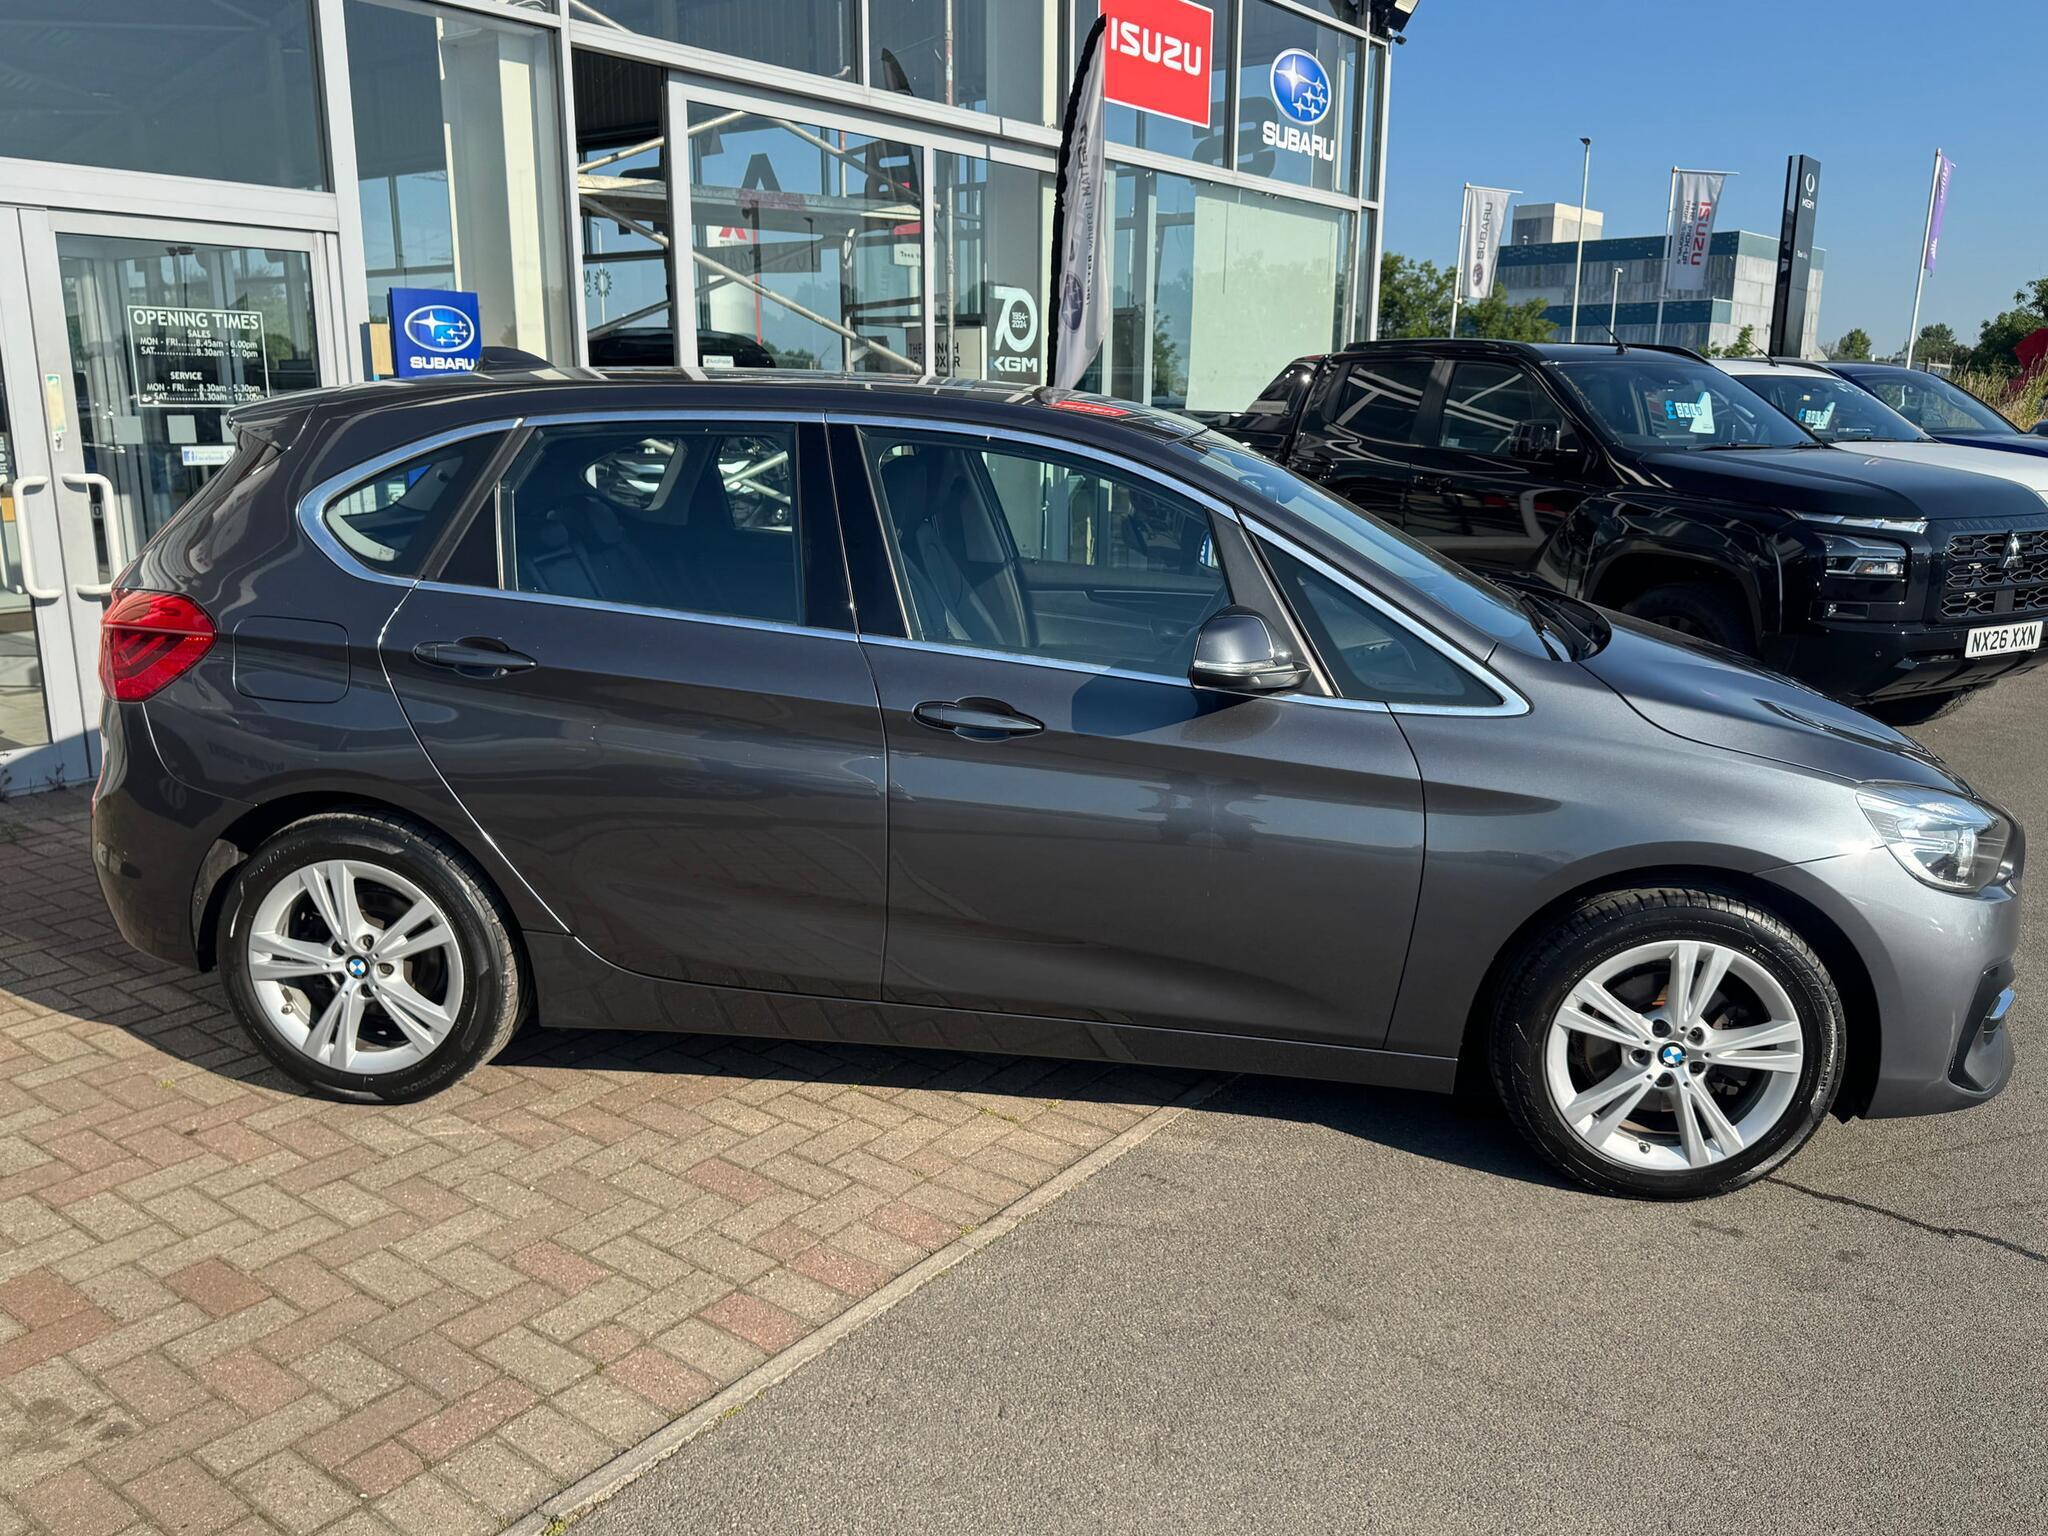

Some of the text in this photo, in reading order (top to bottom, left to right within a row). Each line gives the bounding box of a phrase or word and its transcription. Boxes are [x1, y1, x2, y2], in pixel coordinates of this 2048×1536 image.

[1110, 18, 1201, 76] ISUZU
[1262, 121, 1334, 162] SUBARU
[1084, 212, 1094, 249] where
[1477, 202, 1493, 260] SUBARU
[1690, 202, 1712, 266] ISUZU
[133, 310, 259, 330] OPENING TIMES
[990, 285, 1038, 352] 70
[140, 337, 159, 346] MON
[187, 329, 211, 338] SALES
[410, 356, 475, 370] SUBARU
[989, 356, 1038, 373] KGM
[170, 371, 203, 381] SERVICE
[147, 383, 165, 392] MON
[233, 385, 261, 394] 5.30pm
[1971, 624, 2037, 653] NX26 XXN
